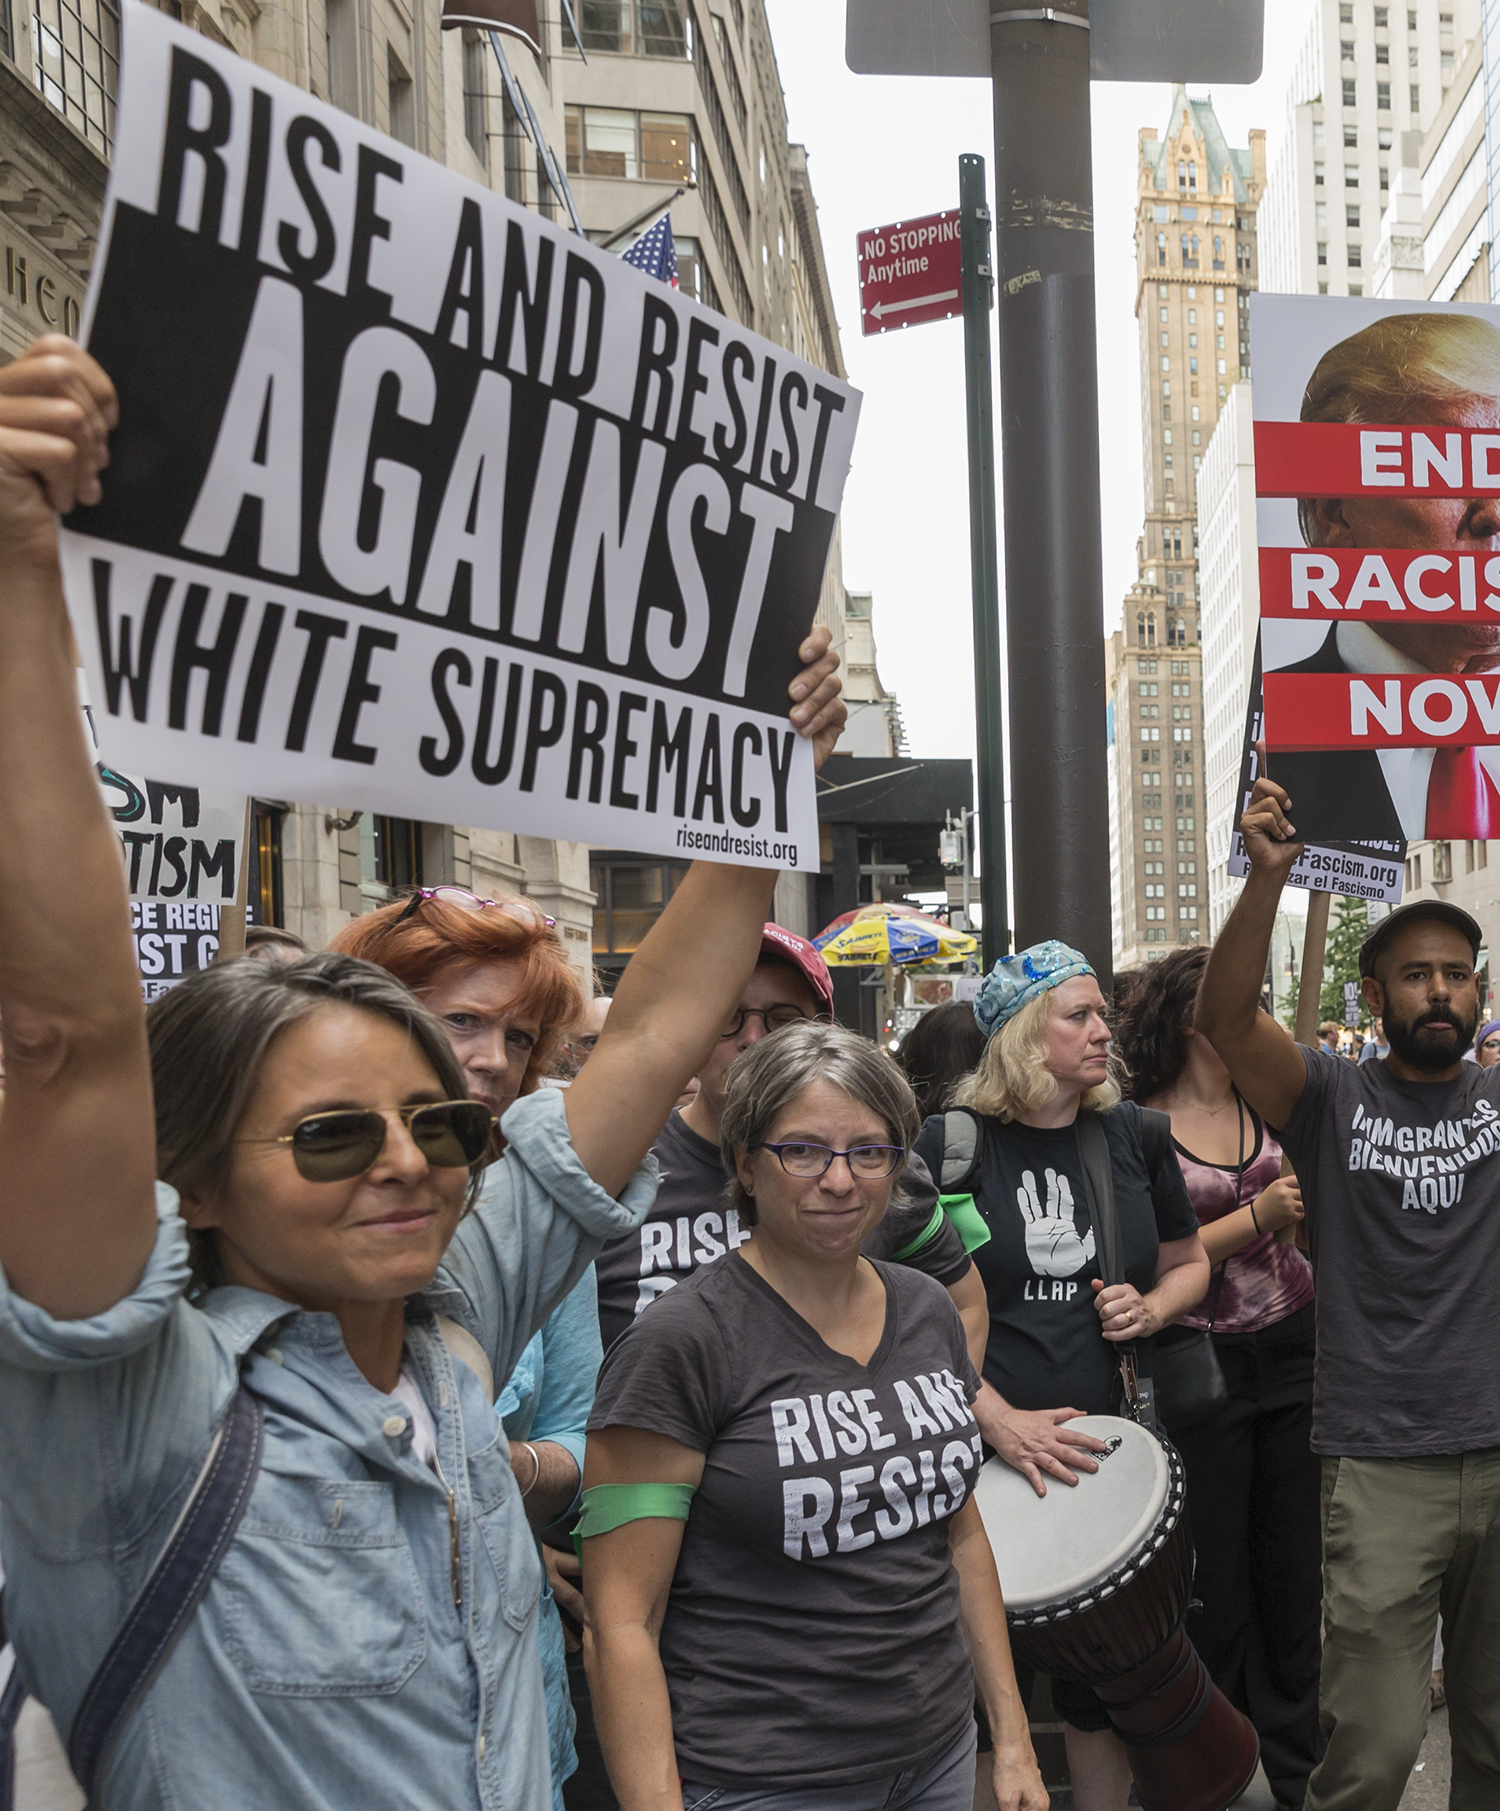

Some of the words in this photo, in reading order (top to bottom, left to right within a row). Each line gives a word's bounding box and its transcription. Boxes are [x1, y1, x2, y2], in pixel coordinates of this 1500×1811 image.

[864, 238, 886, 260] NO
[890, 219, 961, 255] STOPPING
[157, 45, 404, 317] RISE
[436, 197, 607, 399] AND
[633, 291, 846, 511] RESIST
[868, 256, 929, 284] Anytime
[181, 276, 794, 698] AGAINST
[90, 559, 398, 765] WHITE
[419, 647, 797, 833] SUPREMACY
[118, 829, 236, 899] TISM
[676, 823, 798, 867] riseandresist.org
[1314, 874, 1327, 889] el
[1332, 876, 1385, 900] Fascismo
[1402, 1173, 1465, 1215] AQUI
[1023, 1280, 1078, 1302] LLAP
[771, 1388, 897, 1468] RISE
